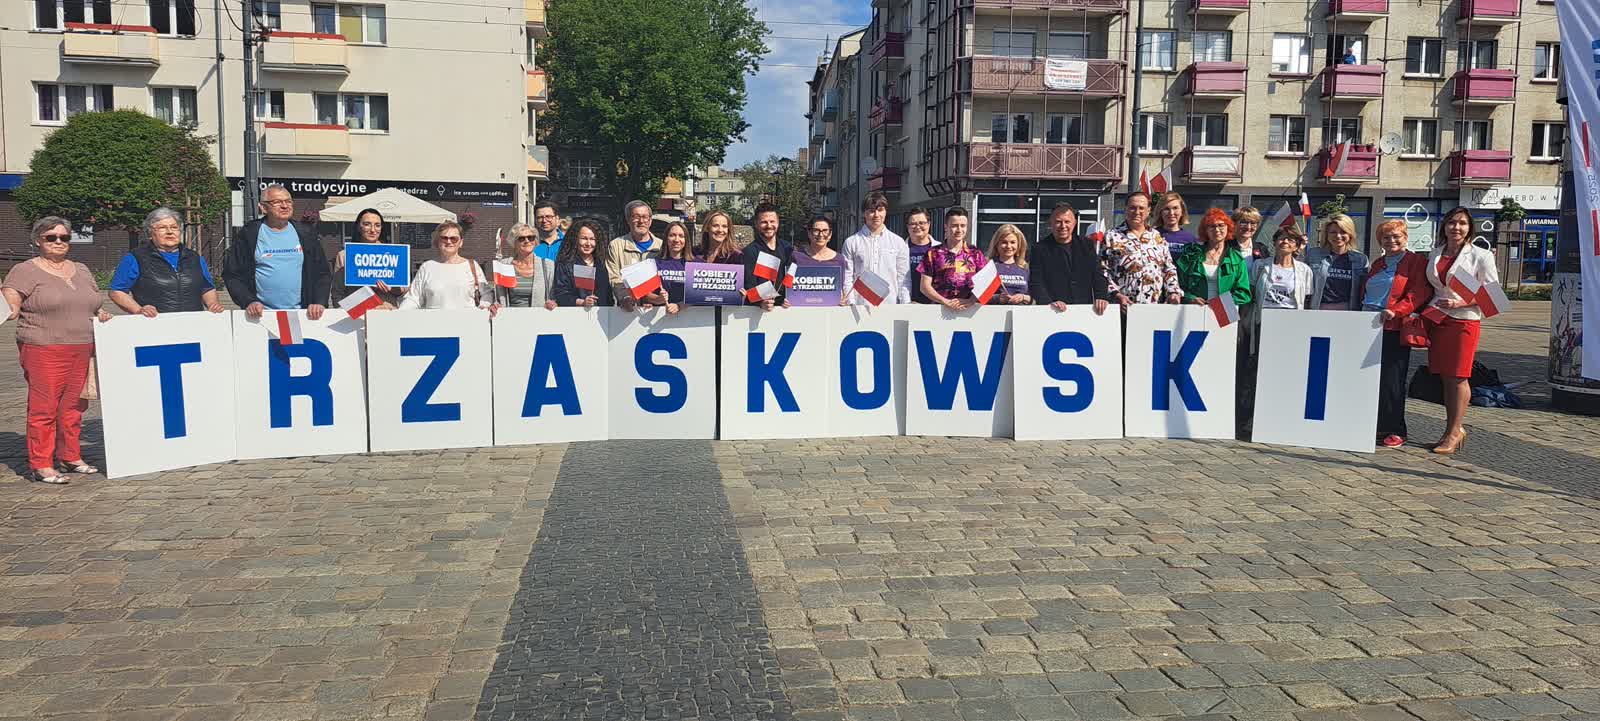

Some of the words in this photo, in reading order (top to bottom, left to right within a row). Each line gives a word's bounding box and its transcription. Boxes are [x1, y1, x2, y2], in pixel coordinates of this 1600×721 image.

[292, 181, 367, 195] tradycyjne
[354, 252, 399, 267] GORZÓW
[358, 268, 394, 278] NAPRZÓD!
[693, 269, 737, 279] KOBIETY
[793, 276, 836, 285] KOBIETY
[692, 282, 736, 291] #TRZA2025
